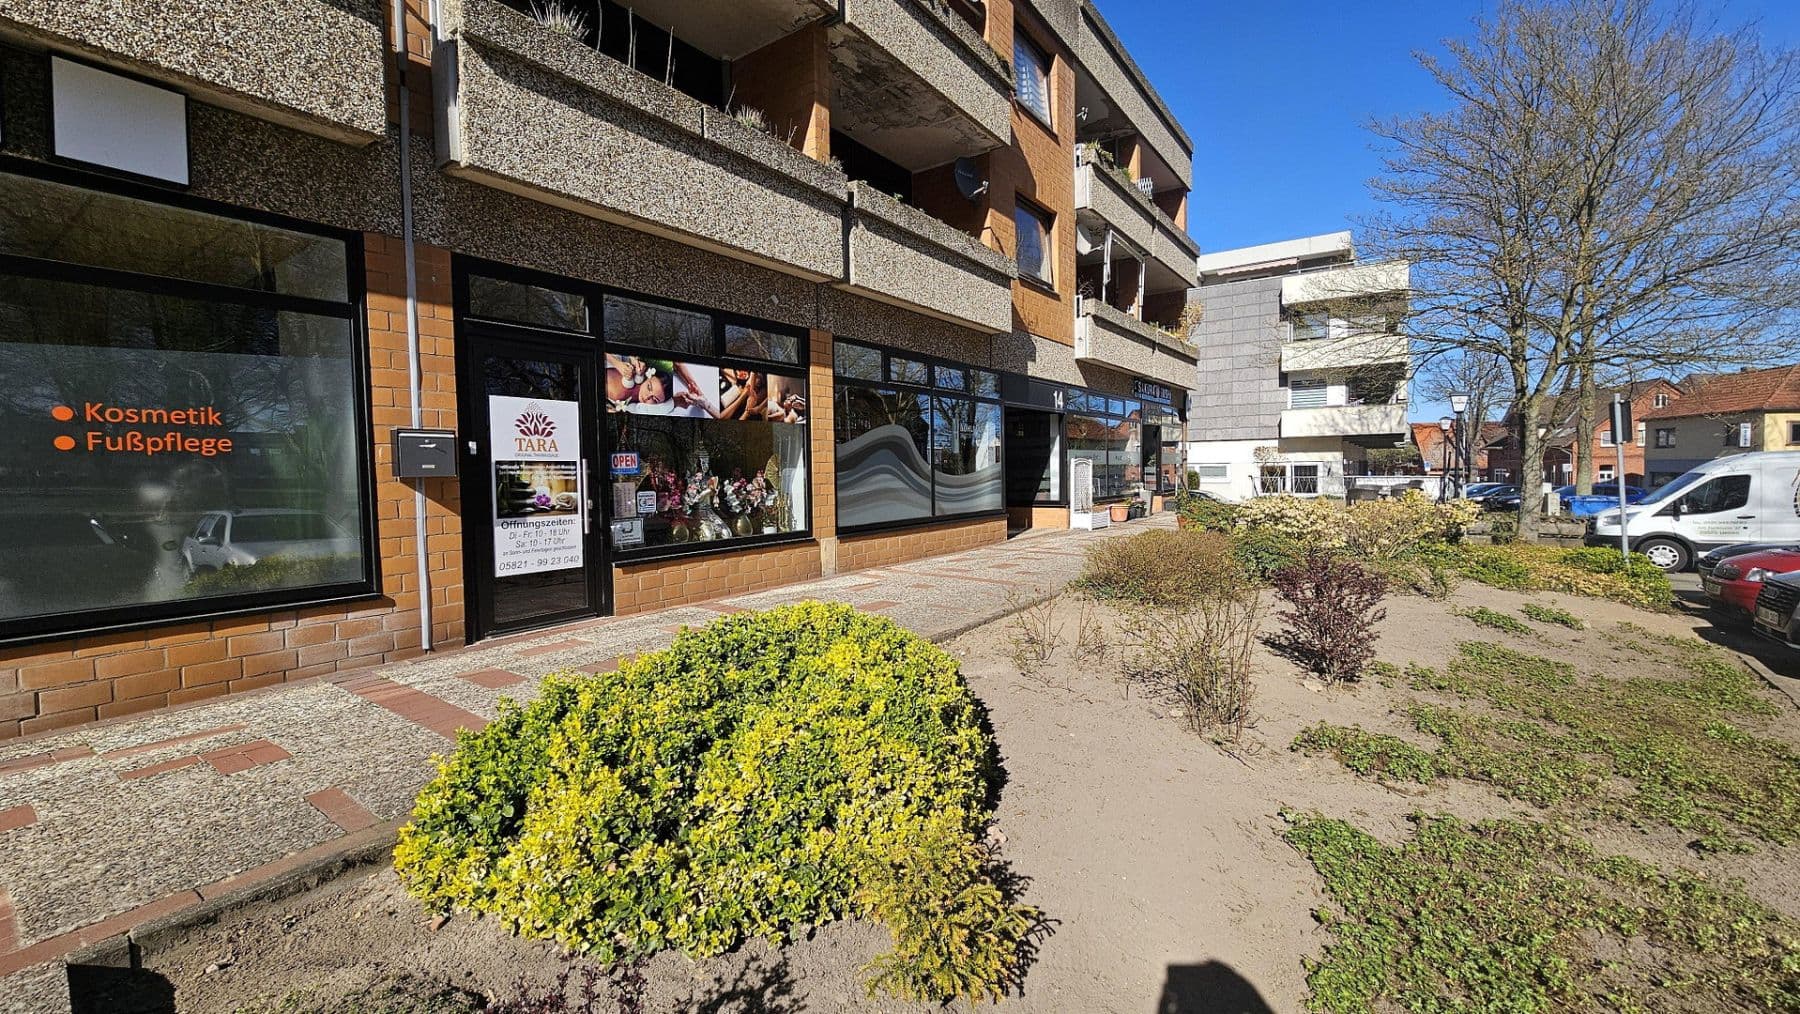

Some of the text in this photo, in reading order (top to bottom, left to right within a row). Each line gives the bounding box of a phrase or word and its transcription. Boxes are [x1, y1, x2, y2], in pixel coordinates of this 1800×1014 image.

[1053, 391, 1064, 410] 14
[85, 402, 223, 425] Kosmetik
[87, 431, 233, 456] Fußpflege
[514, 438, 559, 452] TARA
[612, 455, 636, 468] OPEN
[501, 517, 577, 530] Öffnungszeiten:
[535, 530, 544, 538] 10
[558, 528, 570, 536] Uhr
[529, 539, 538, 547] 10
[544, 538, 552, 546] 17
[553, 537, 566, 545] Uhr
[498, 560, 528, 571] 05821
[537, 558, 548, 567] 99
[550, 557, 562, 566] 23
